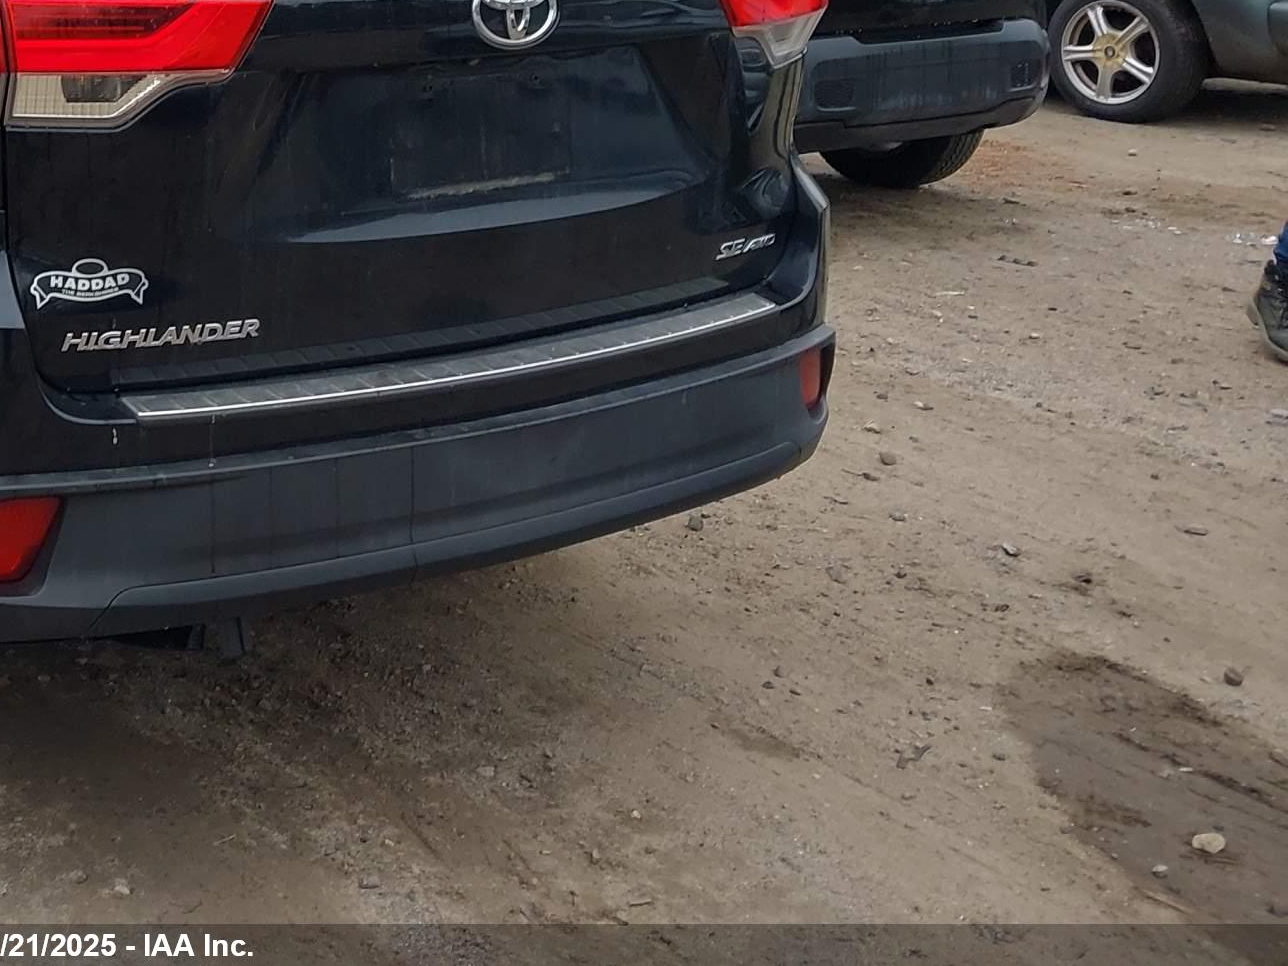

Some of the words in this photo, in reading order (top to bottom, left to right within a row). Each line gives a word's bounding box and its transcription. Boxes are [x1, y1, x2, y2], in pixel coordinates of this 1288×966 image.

[715, 237, 746, 261] SE
[49, 273, 130, 291] HADDAD
[60, 317, 261, 353] HIGHLANDER
